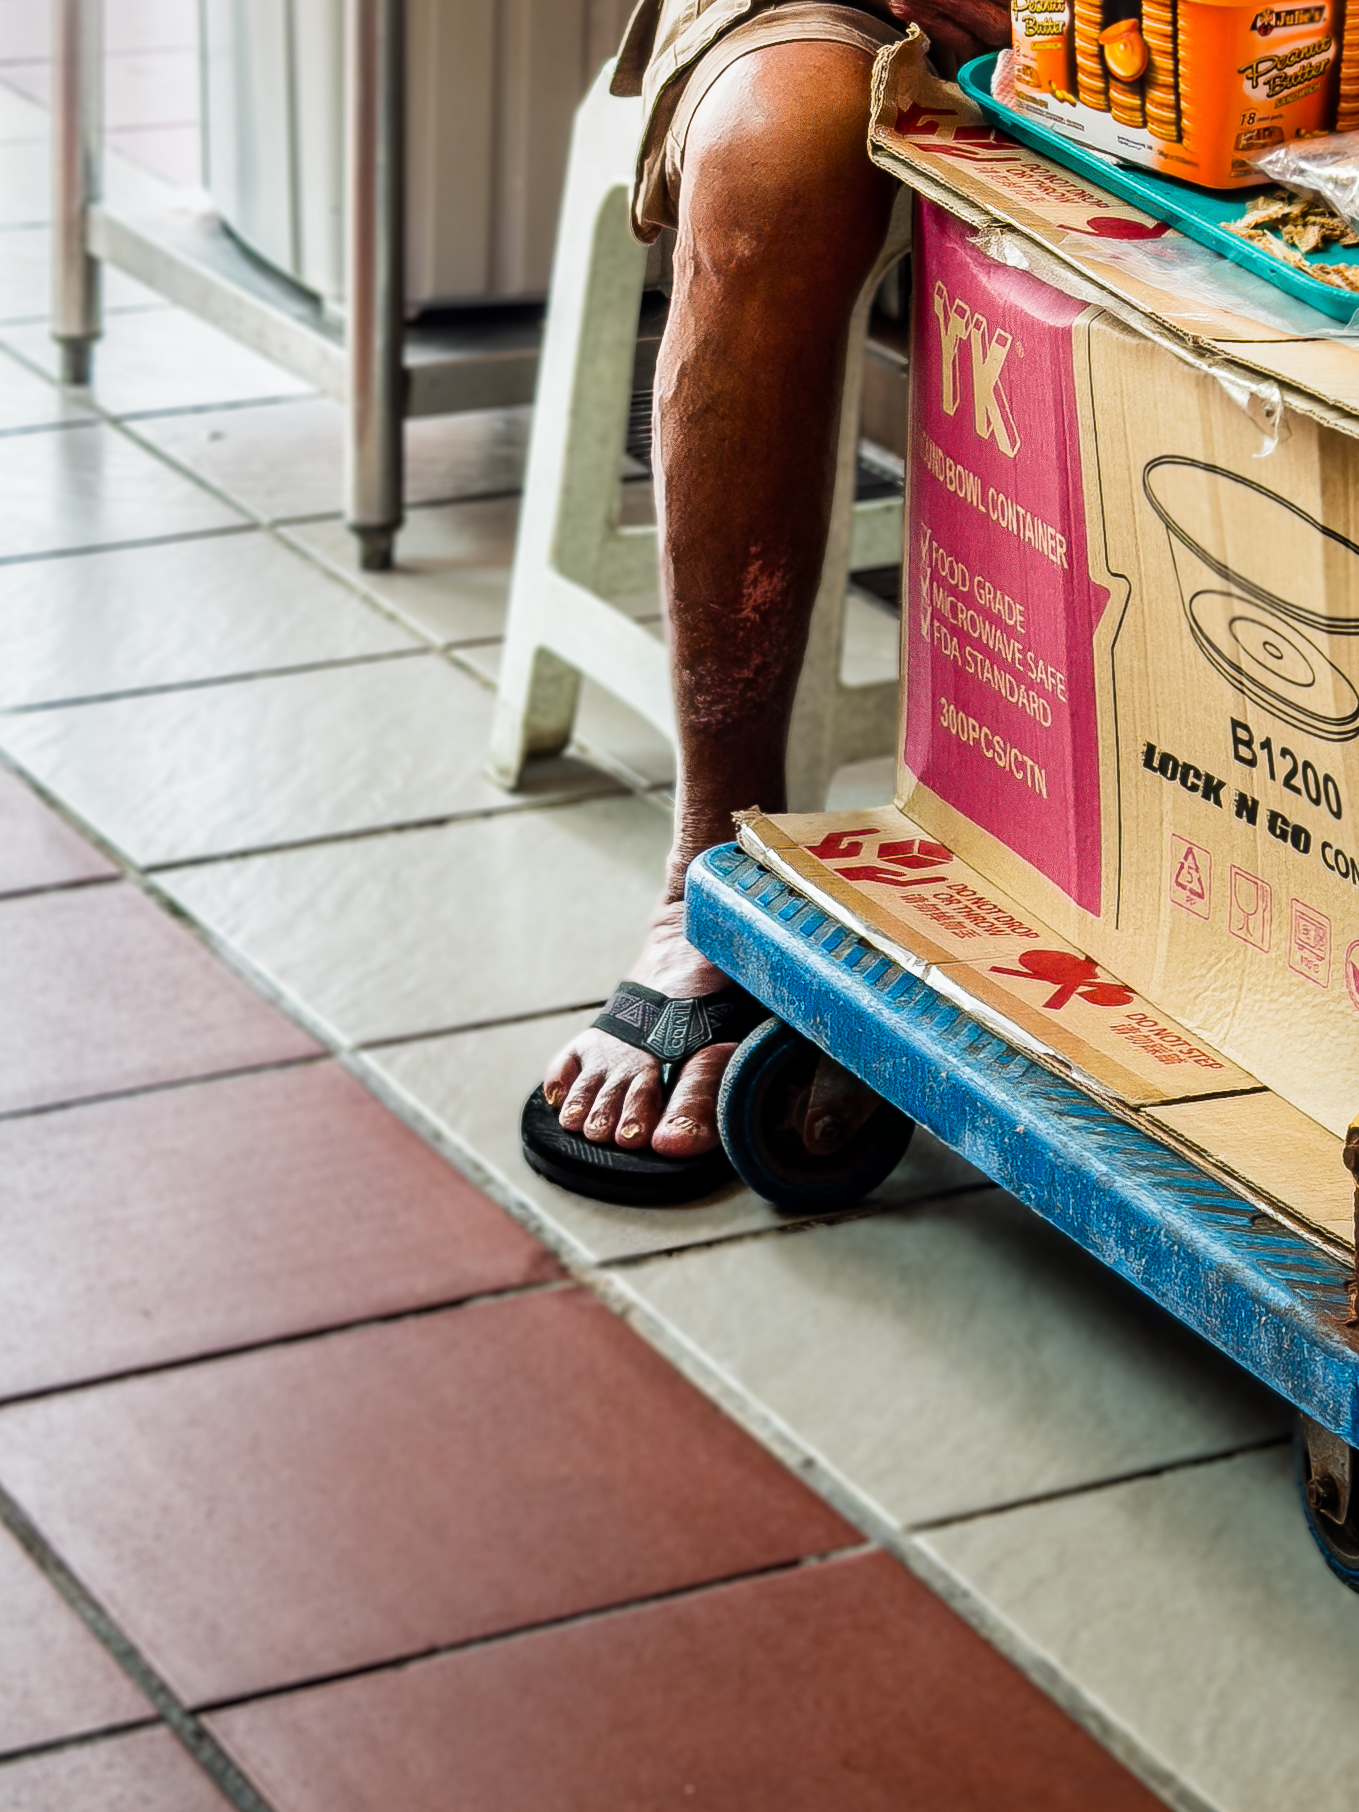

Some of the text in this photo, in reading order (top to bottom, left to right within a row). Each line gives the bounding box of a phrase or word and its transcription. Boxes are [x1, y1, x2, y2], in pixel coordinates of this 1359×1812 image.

[1022, 15, 1065, 37] Butter
[1276, 10, 1321, 27] Julie's
[1237, 35, 1332, 89] Peanut
[1263, 58, 1330, 98] Butter
[934, 280, 1021, 458] YK
[945, 456, 987, 513] BOWL
[988, 487, 1069, 569] CONTAINER
[932, 541, 1026, 634] FOOD GRADE
[932, 582, 1067, 703] MICROWAVE SAFE
[932, 620, 1052, 727] FDA STANDARD
[1142, 740, 1228, 809] LOCK
[1266, 808, 1312, 855] GO
[1230, 716, 1343, 820] B1200
[932, 892, 1011, 936] OR THROW
[946, 883, 1041, 938] DO NOT DROP
[1124, 1012, 1225, 1069] DO NOT STEP
